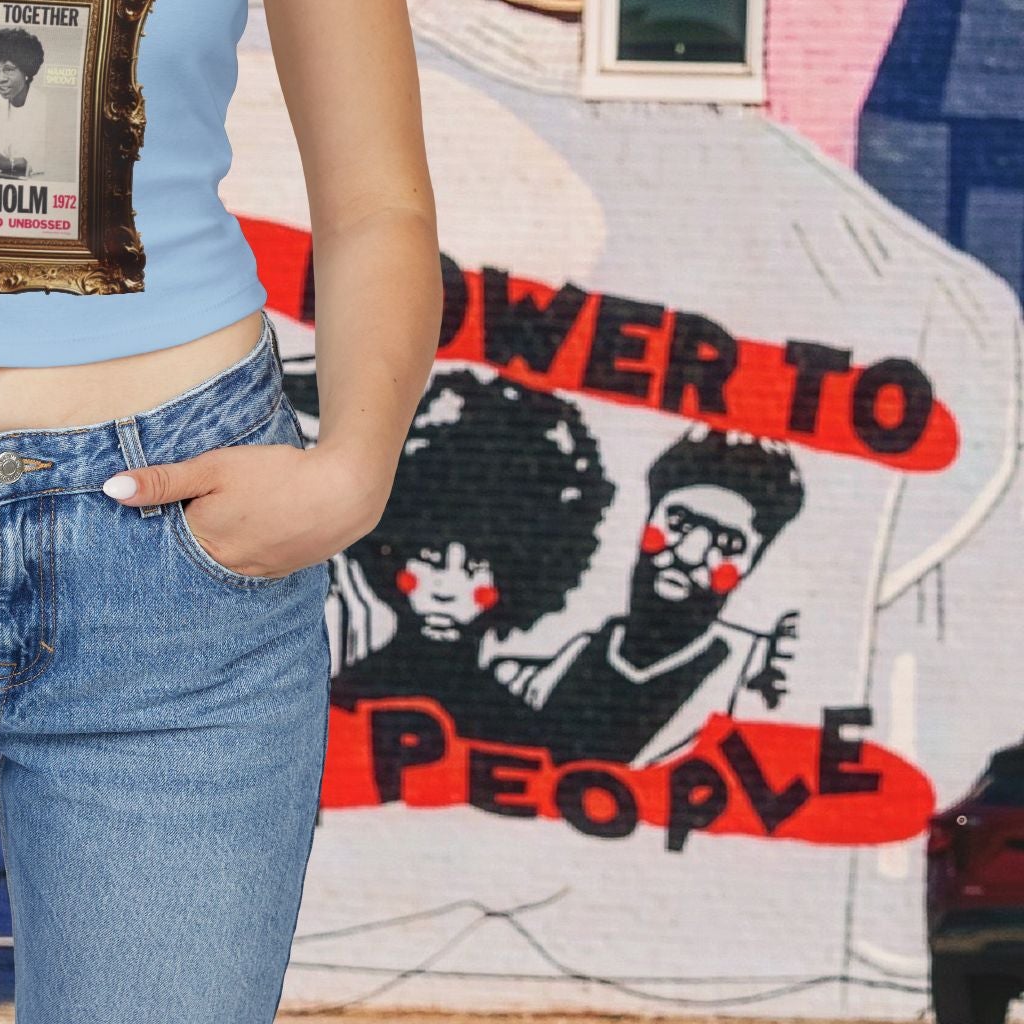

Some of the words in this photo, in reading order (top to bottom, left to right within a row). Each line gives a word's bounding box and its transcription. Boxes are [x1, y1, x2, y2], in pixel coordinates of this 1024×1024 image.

[3, 4, 79, 27] TOGETHER
[52, 194, 77, 209] 1972
[8, 219, 71, 230] UNBOSSED
[300, 242, 739, 416] WER
[783, 339, 936, 454] TO
[369, 706, 883, 854] PEOPLE
